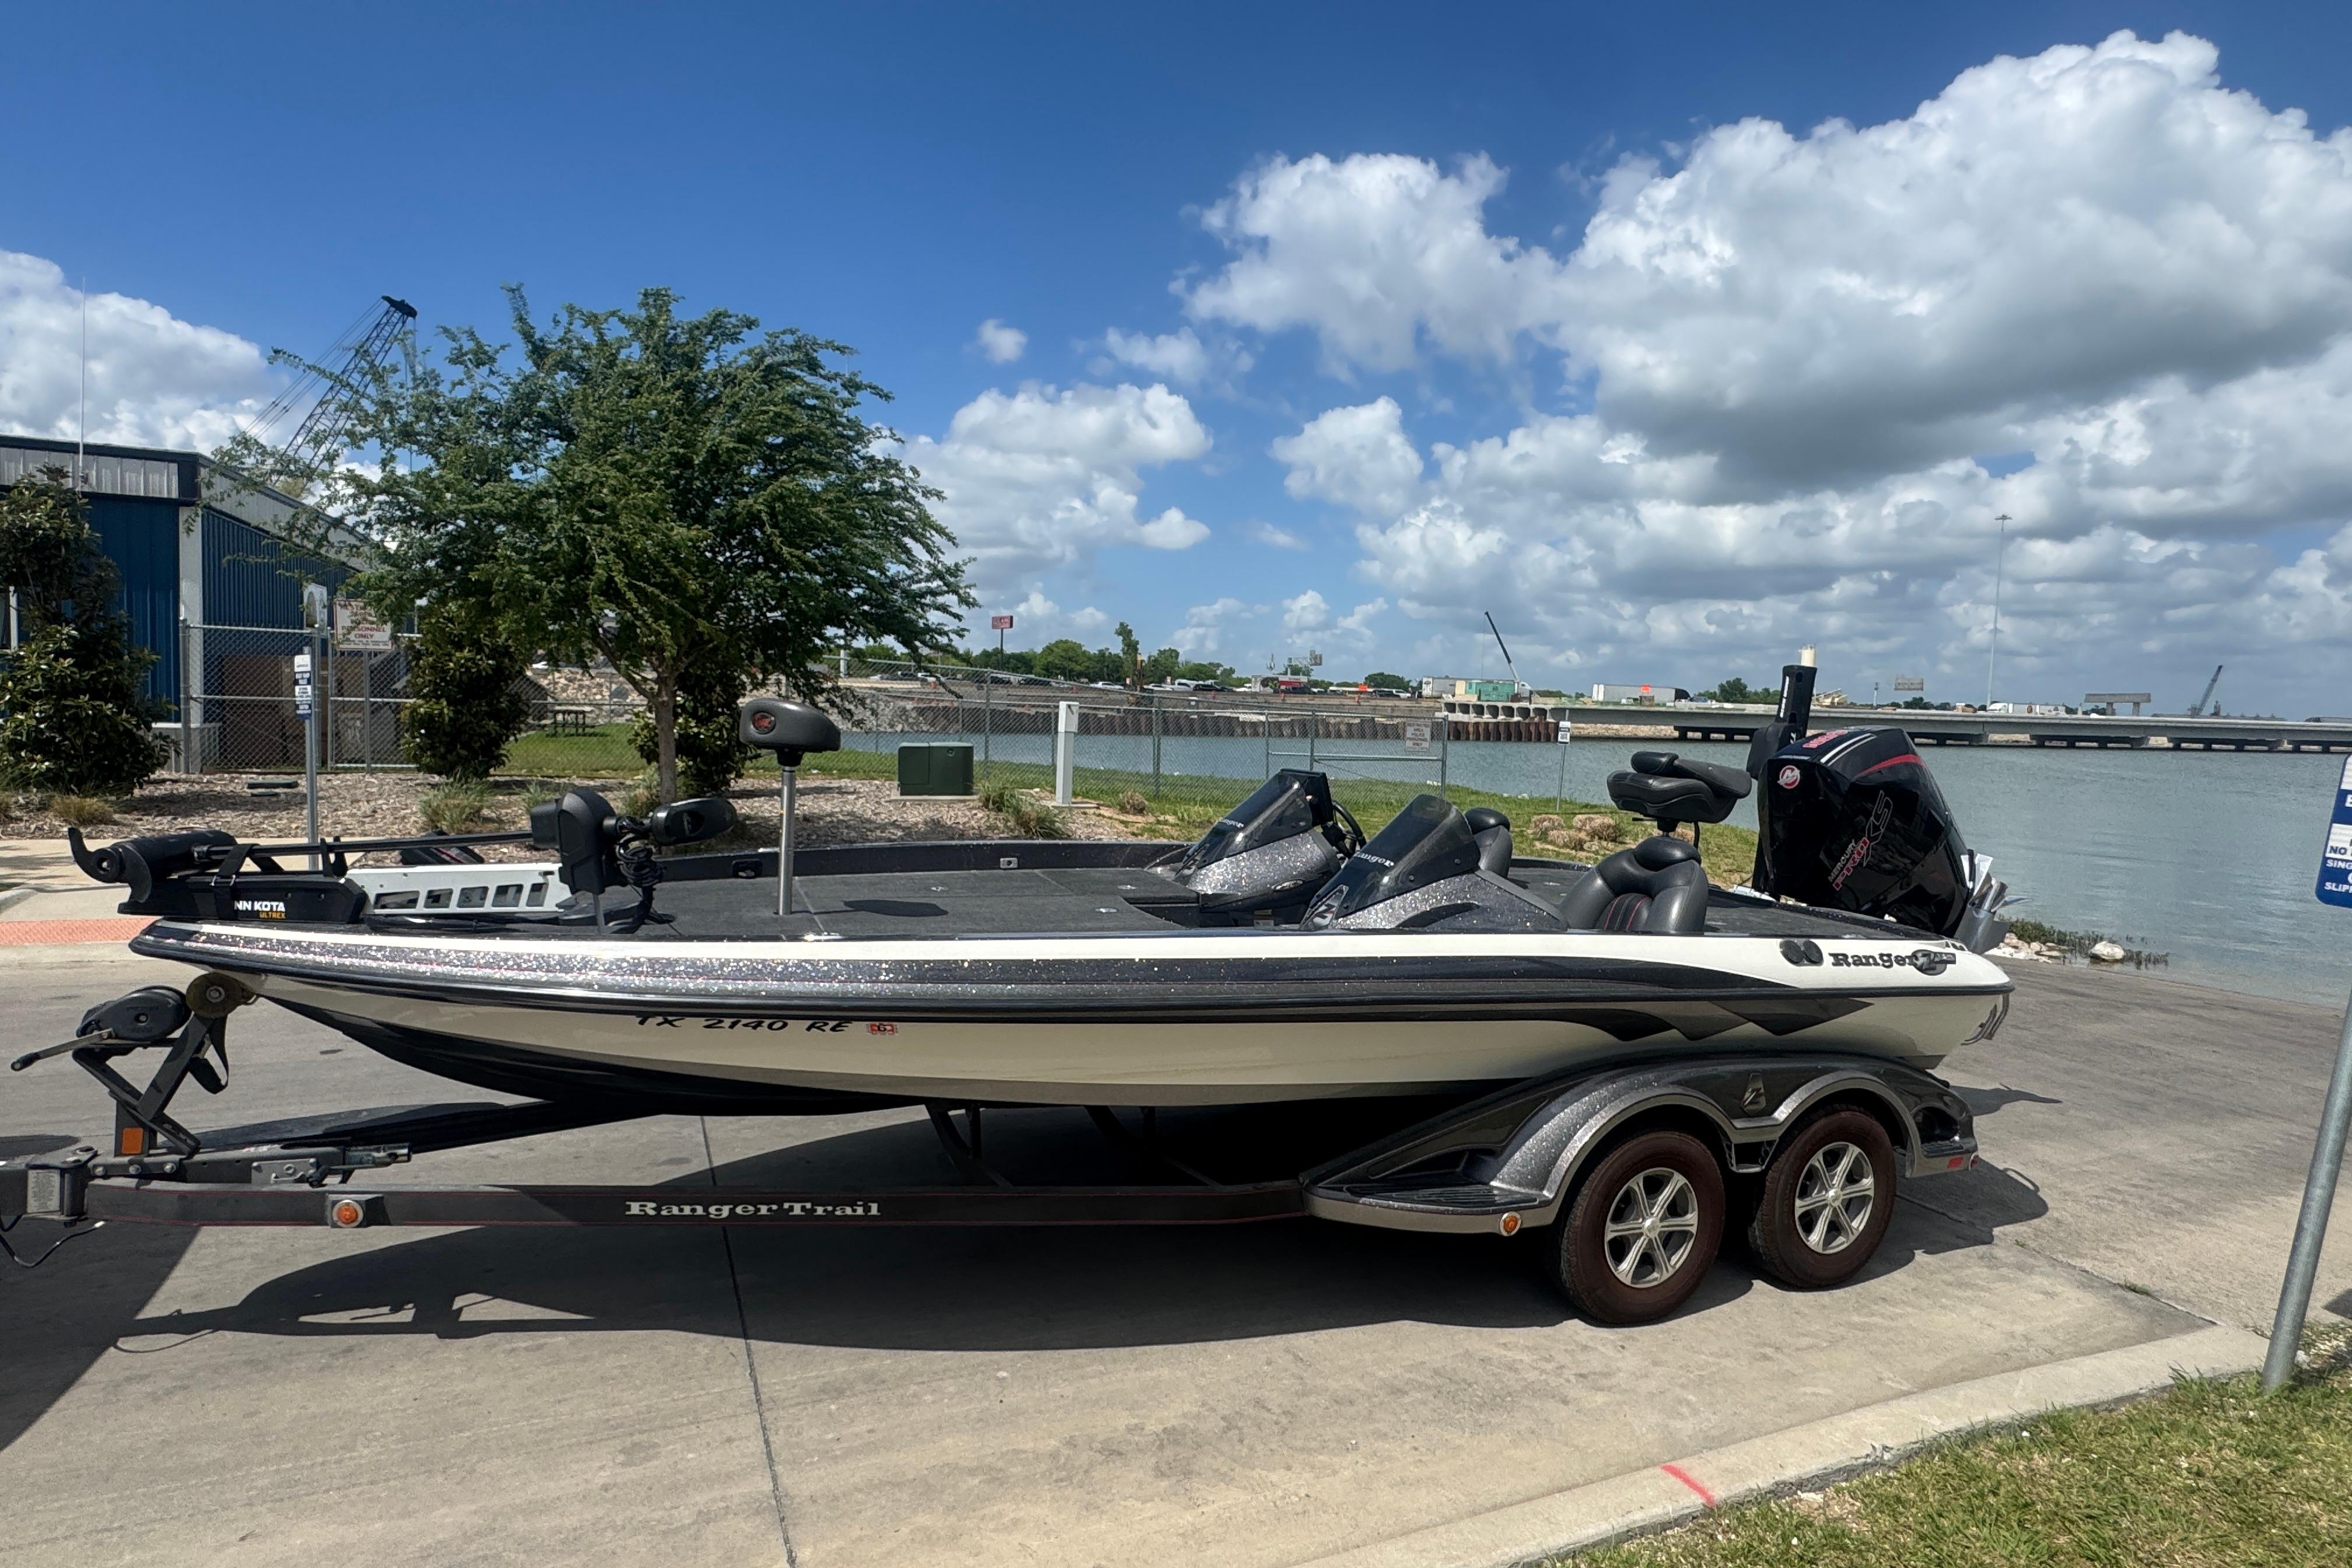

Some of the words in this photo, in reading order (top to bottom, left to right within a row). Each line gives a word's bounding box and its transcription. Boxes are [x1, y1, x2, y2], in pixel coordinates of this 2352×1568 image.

[2328, 845, 2347, 856] NO
[1828, 839, 1856, 883] MERCURY
[254, 901, 286, 912] KOTA
[258, 911, 286, 919] ULTREX
[1828, 952, 1917, 969] Ranger
[636, 1016, 685, 1028] TX
[702, 1018, 789, 1031] 2140
[805, 1020, 854, 1032] RE
[625, 1200, 778, 1219] Ranger
[783, 1200, 881, 1216] Trail
